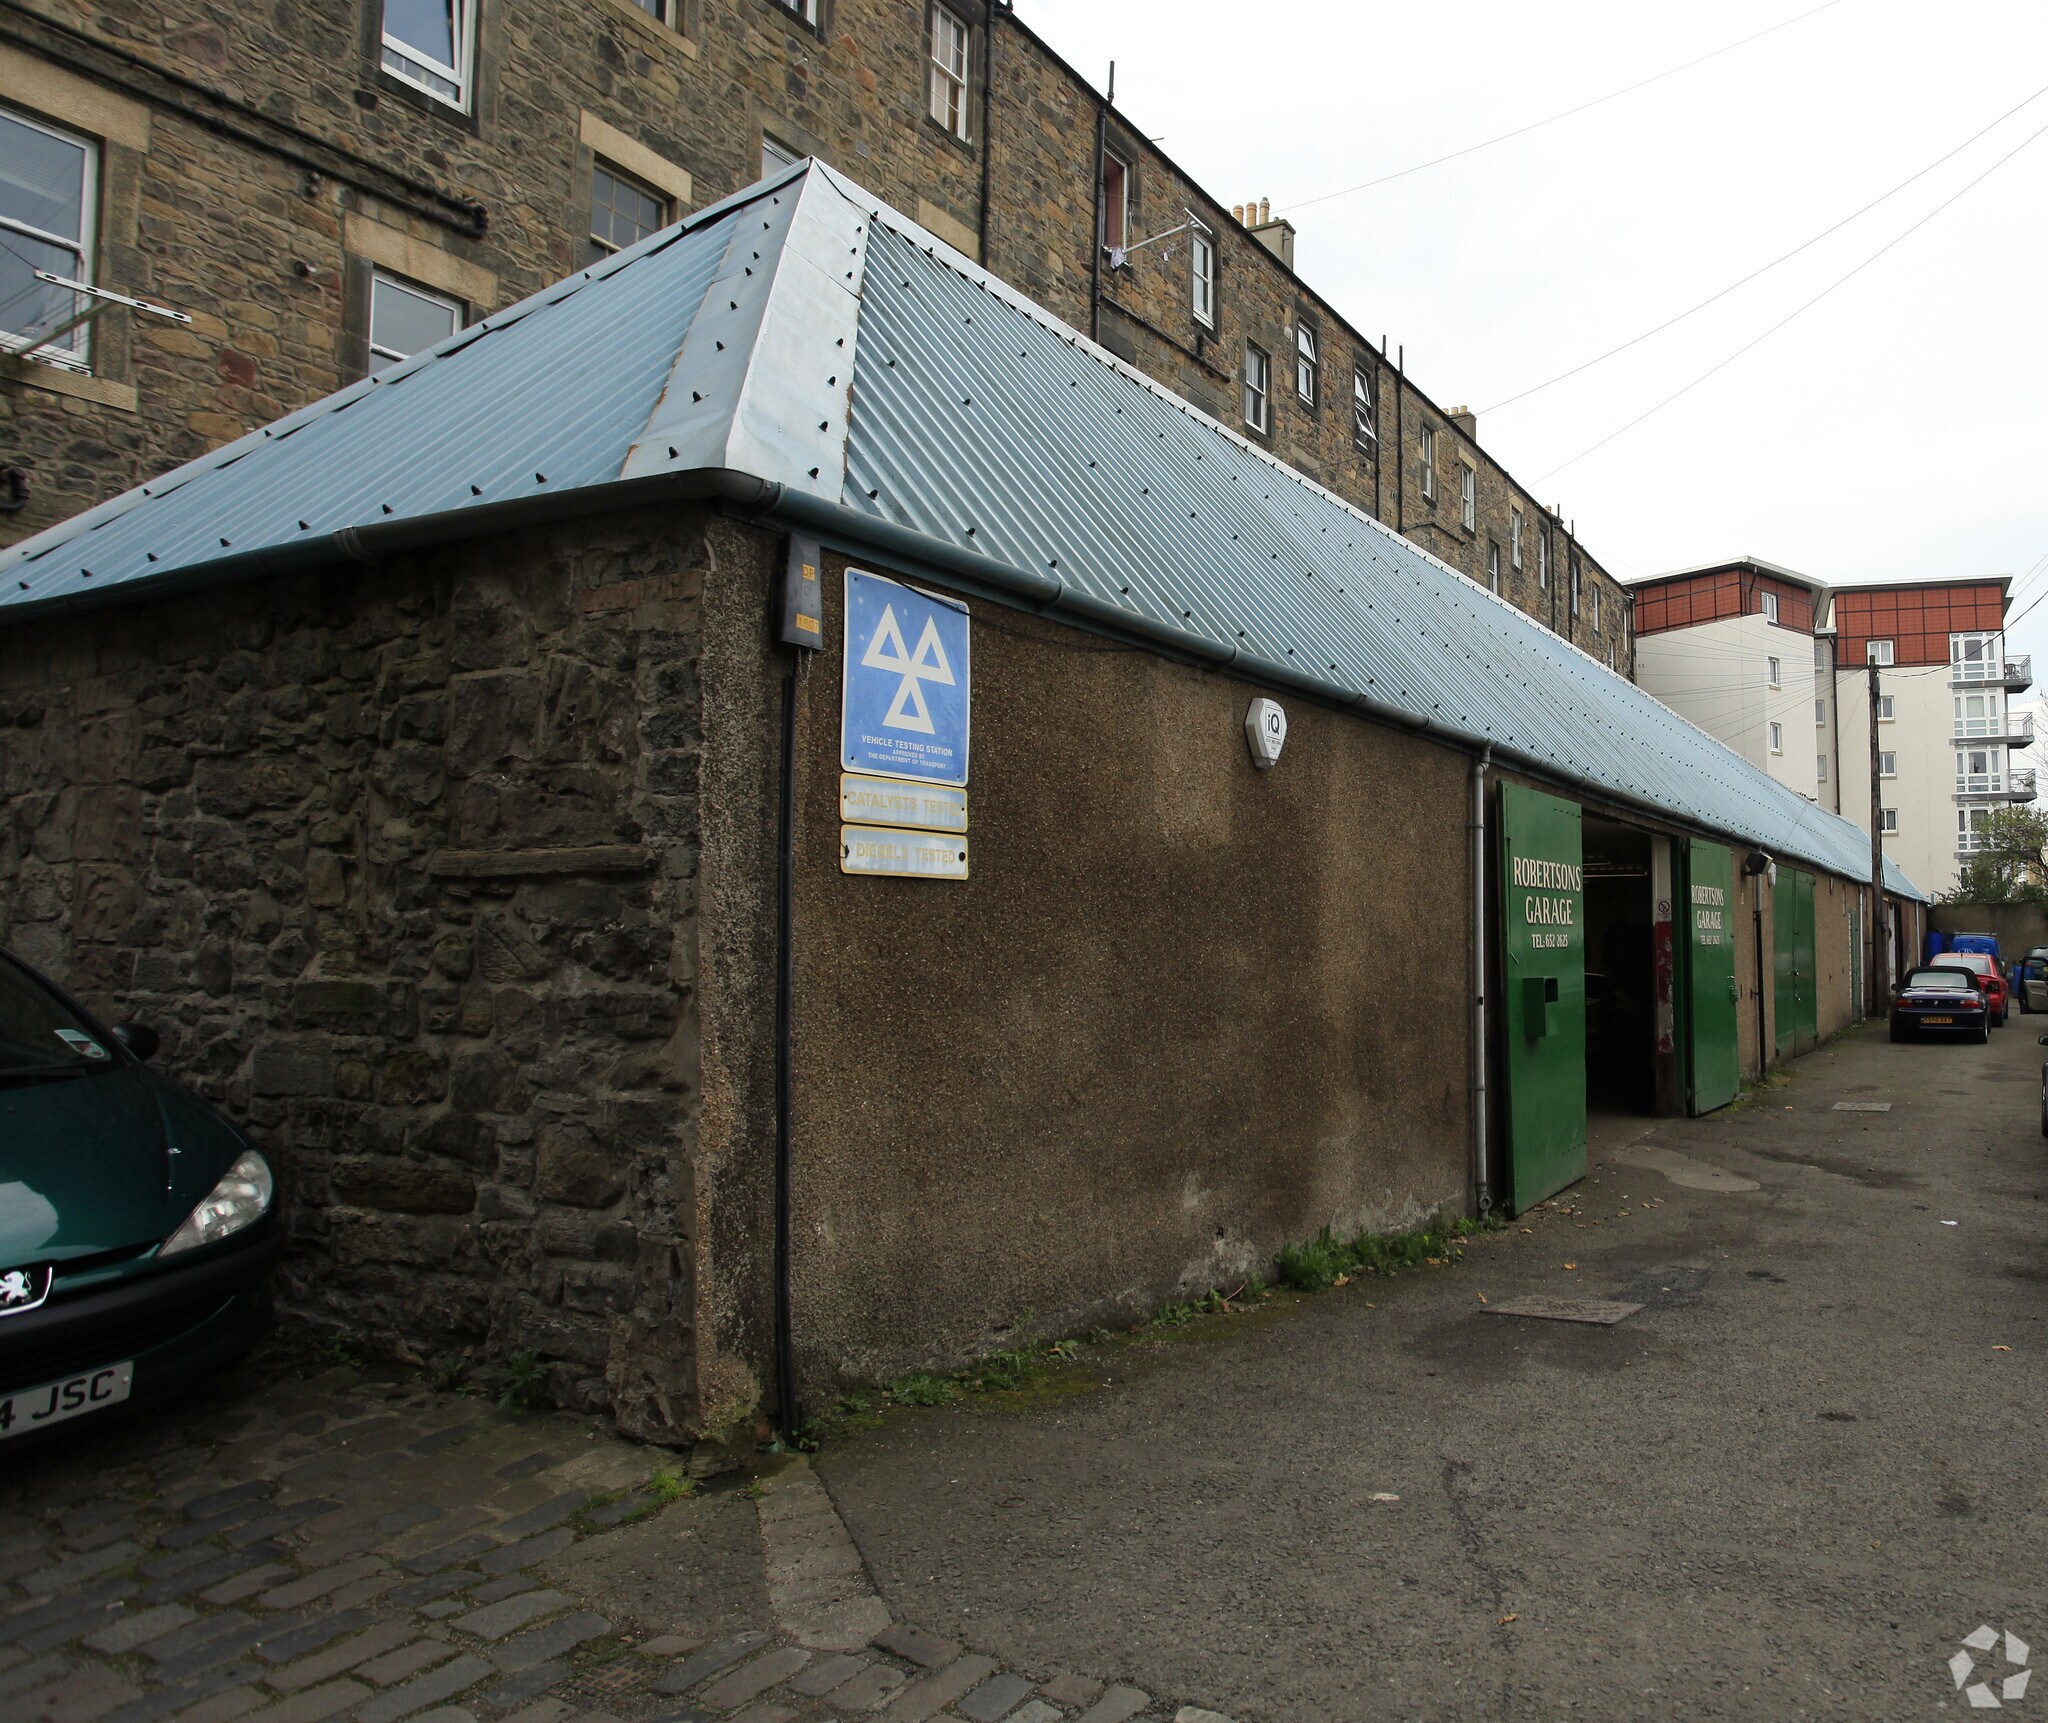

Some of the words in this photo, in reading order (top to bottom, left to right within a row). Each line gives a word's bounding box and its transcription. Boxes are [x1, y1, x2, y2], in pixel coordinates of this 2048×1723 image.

[1268, 713, 1280, 735] iQ
[862, 735, 893, 747] VEHICLE
[895, 740, 924, 752] TESTING
[926, 745, 953, 757] STATION
[892, 749, 918, 759] APPROVED
[868, 752, 878, 760] THE
[879, 753, 911, 764] DEPARTMENT
[919, 759, 947, 769] TRANSPORT
[847, 791, 917, 812] CATALYSTS
[856, 843, 909, 860] DIESELS
[914, 847, 955, 863] TESTED
[1513, 856, 1581, 892] ROBERTSONS
[1691, 885, 1724, 906] ROBERTSONS
[1525, 895, 1574, 926] GARAGE
[1696, 910, 1722, 930] GARAGE
[31, 1369, 115, 1420] JSC
